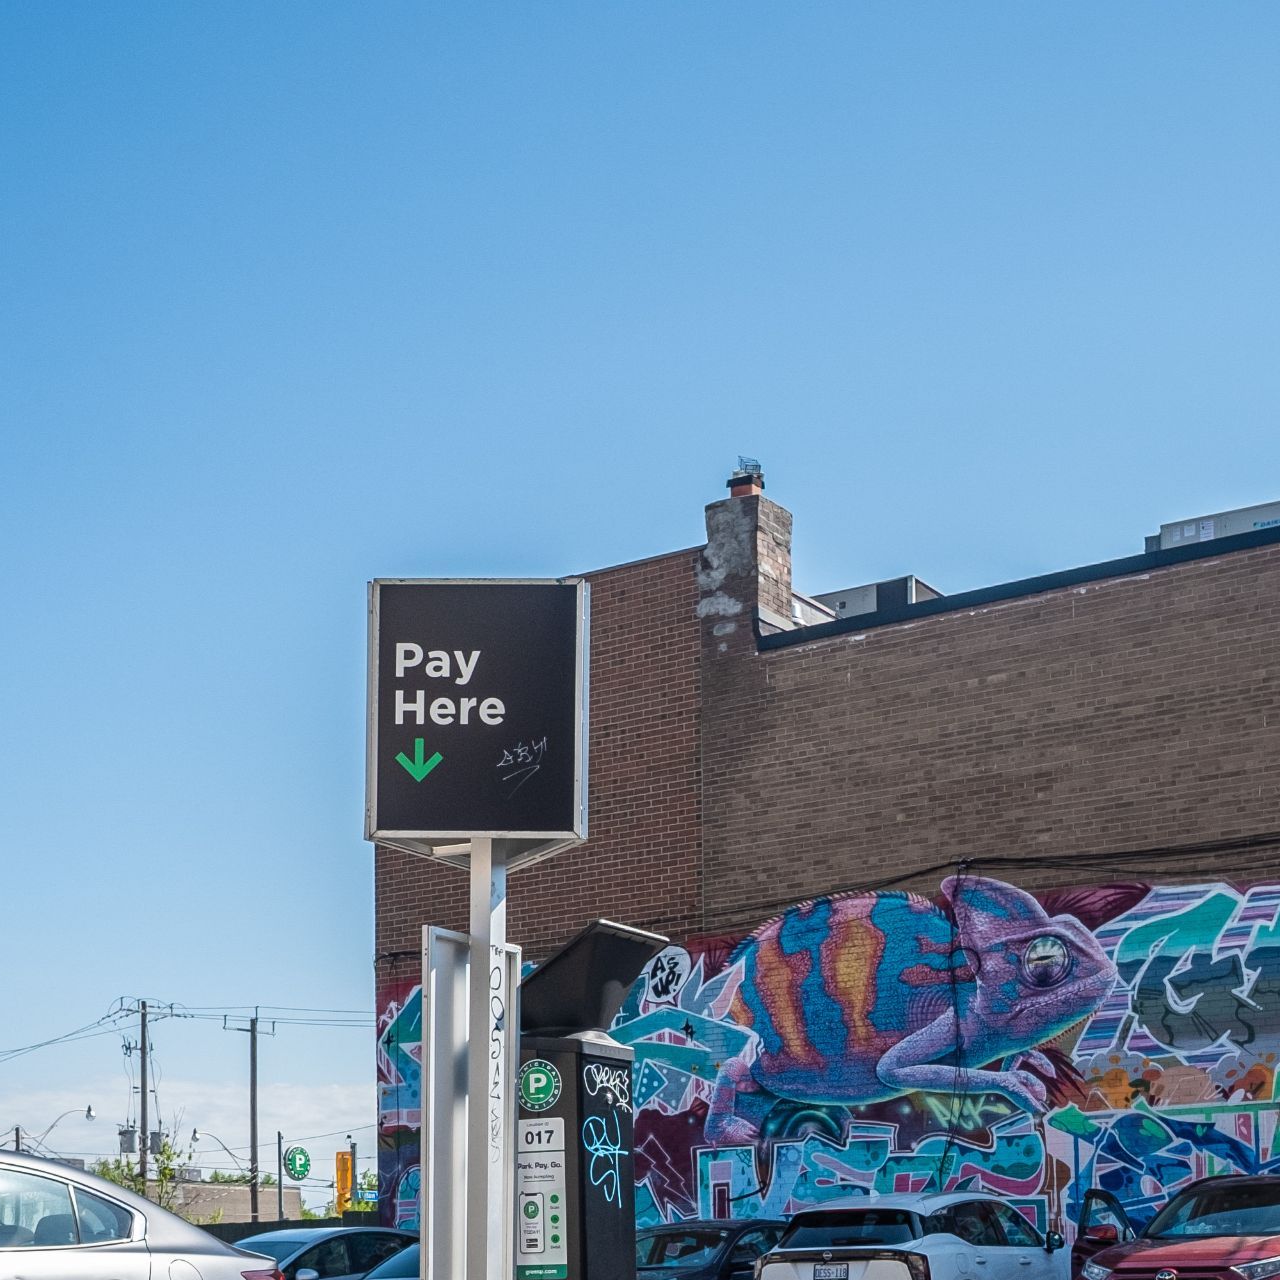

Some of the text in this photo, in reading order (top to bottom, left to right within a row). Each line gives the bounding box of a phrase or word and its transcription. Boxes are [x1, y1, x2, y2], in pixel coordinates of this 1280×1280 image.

[395, 642, 481, 686] Pay
[394, 689, 506, 726] Here
[529, 1073, 547, 1094] P
[525, 1129, 554, 1145] 017
[295, 1154, 306, 1168] P
[535, 1161, 549, 1170] Pay.
